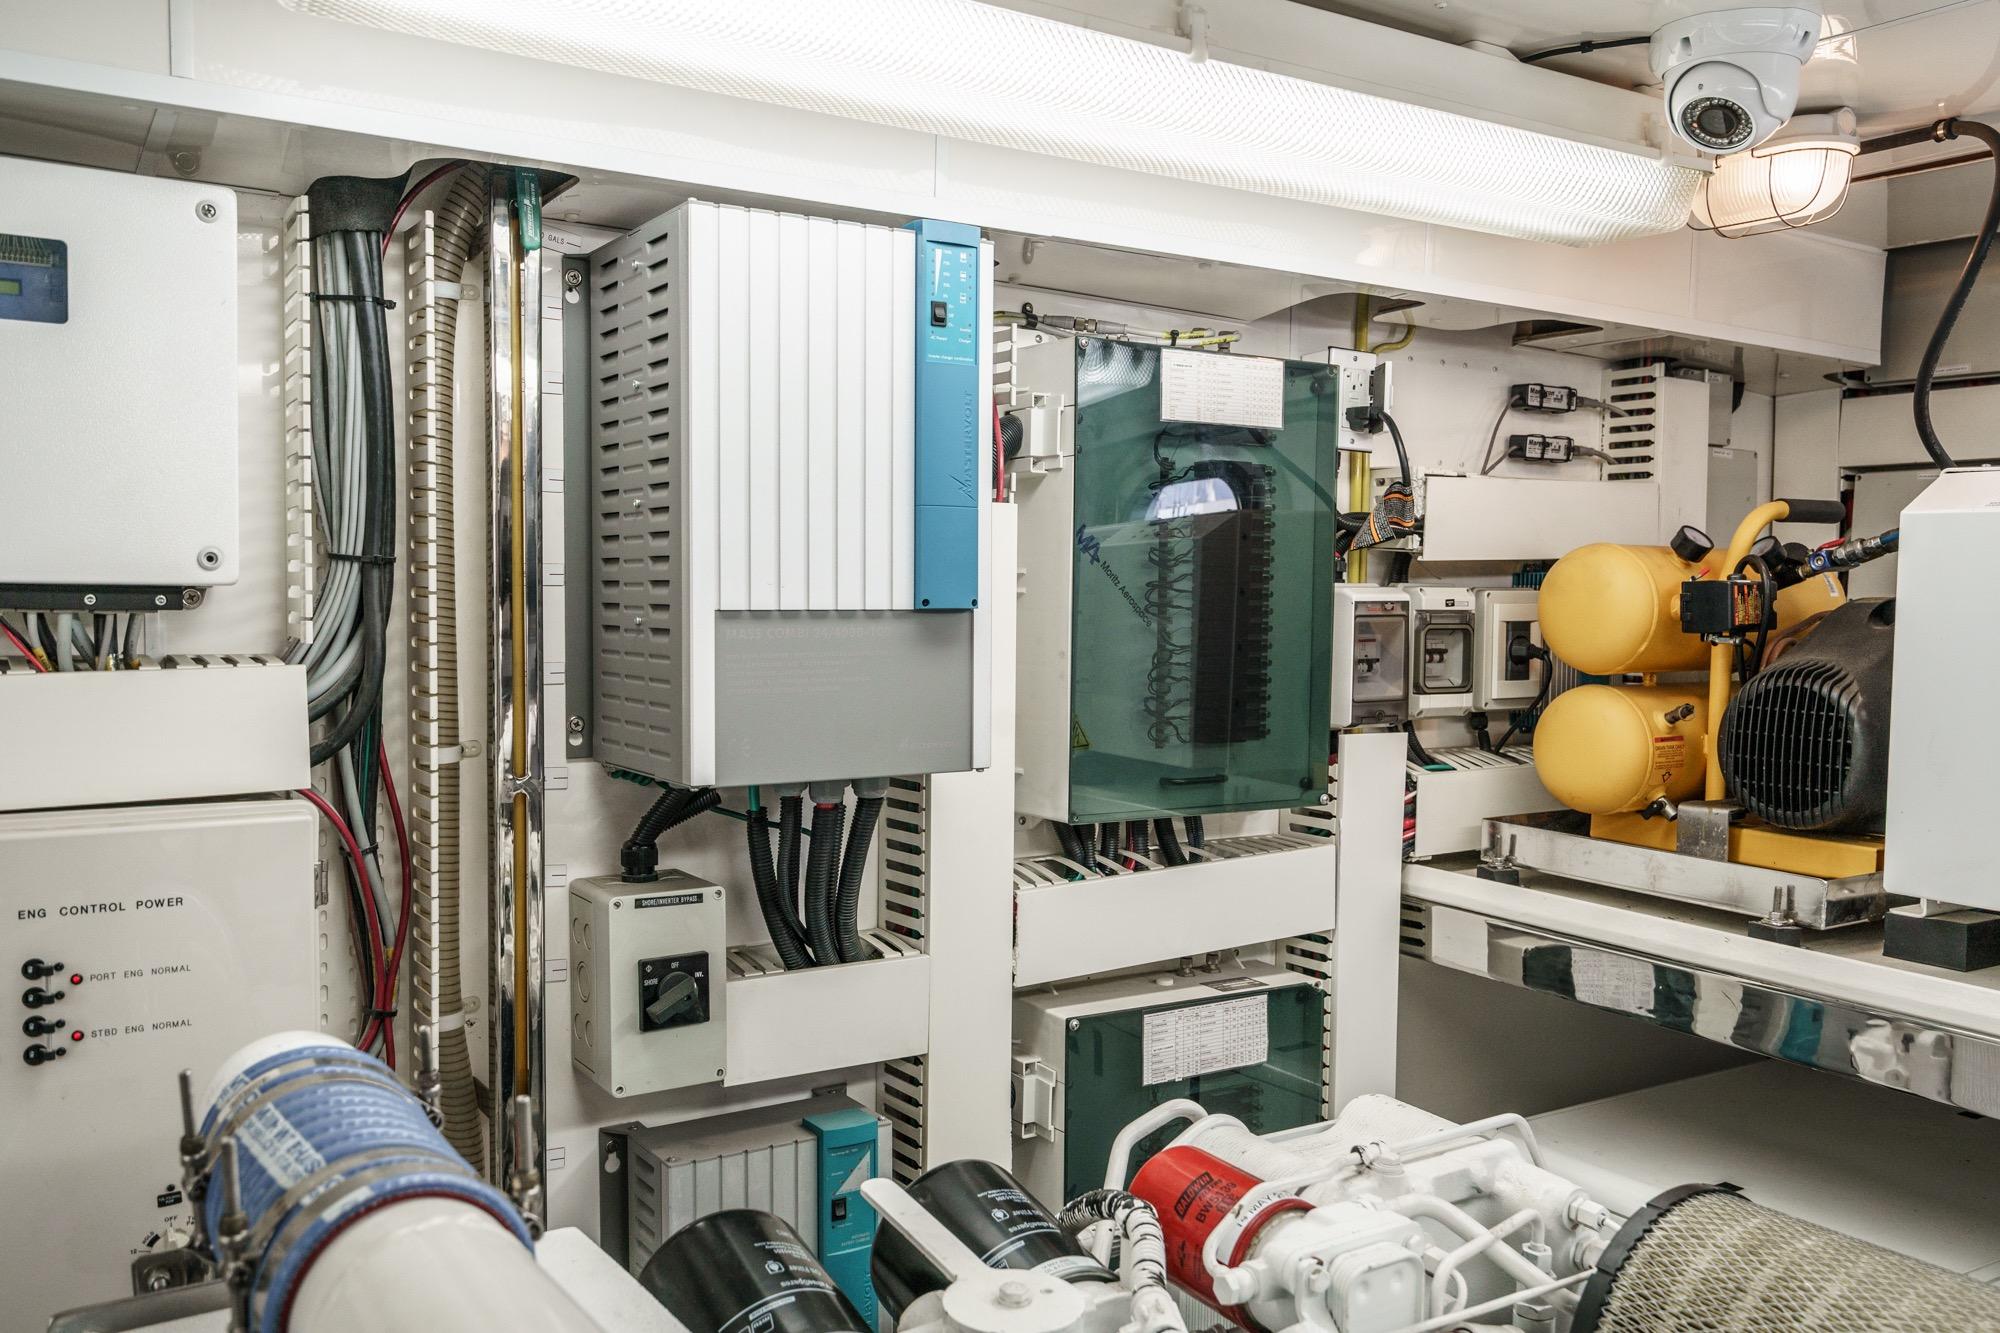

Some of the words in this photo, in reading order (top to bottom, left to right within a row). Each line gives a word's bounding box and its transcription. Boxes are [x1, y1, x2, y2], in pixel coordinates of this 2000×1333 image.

[547, 234, 565, 245] GALS
[1100, 561, 1121, 587] Moritz
[1118, 585, 1153, 628] Aerospace
[680, 895, 698, 903] BYPASS
[18, 909, 47, 920] ENG
[59, 902, 126, 917] CONTROL
[136, 897, 184, 909] POWER
[90, 972, 117, 982] PORT
[124, 970, 144, 979] ENG
[151, 965, 192, 975] NORMAL
[91, 1028, 118, 1038] STBD
[125, 1025, 145, 1034] ENG
[152, 1020, 192, 1030] NORMAL
[1177, 1174, 1212, 1218] BALDWIN
[1250, 1194, 1272, 1214] MAY
[164, 1215, 177, 1223] OFF
